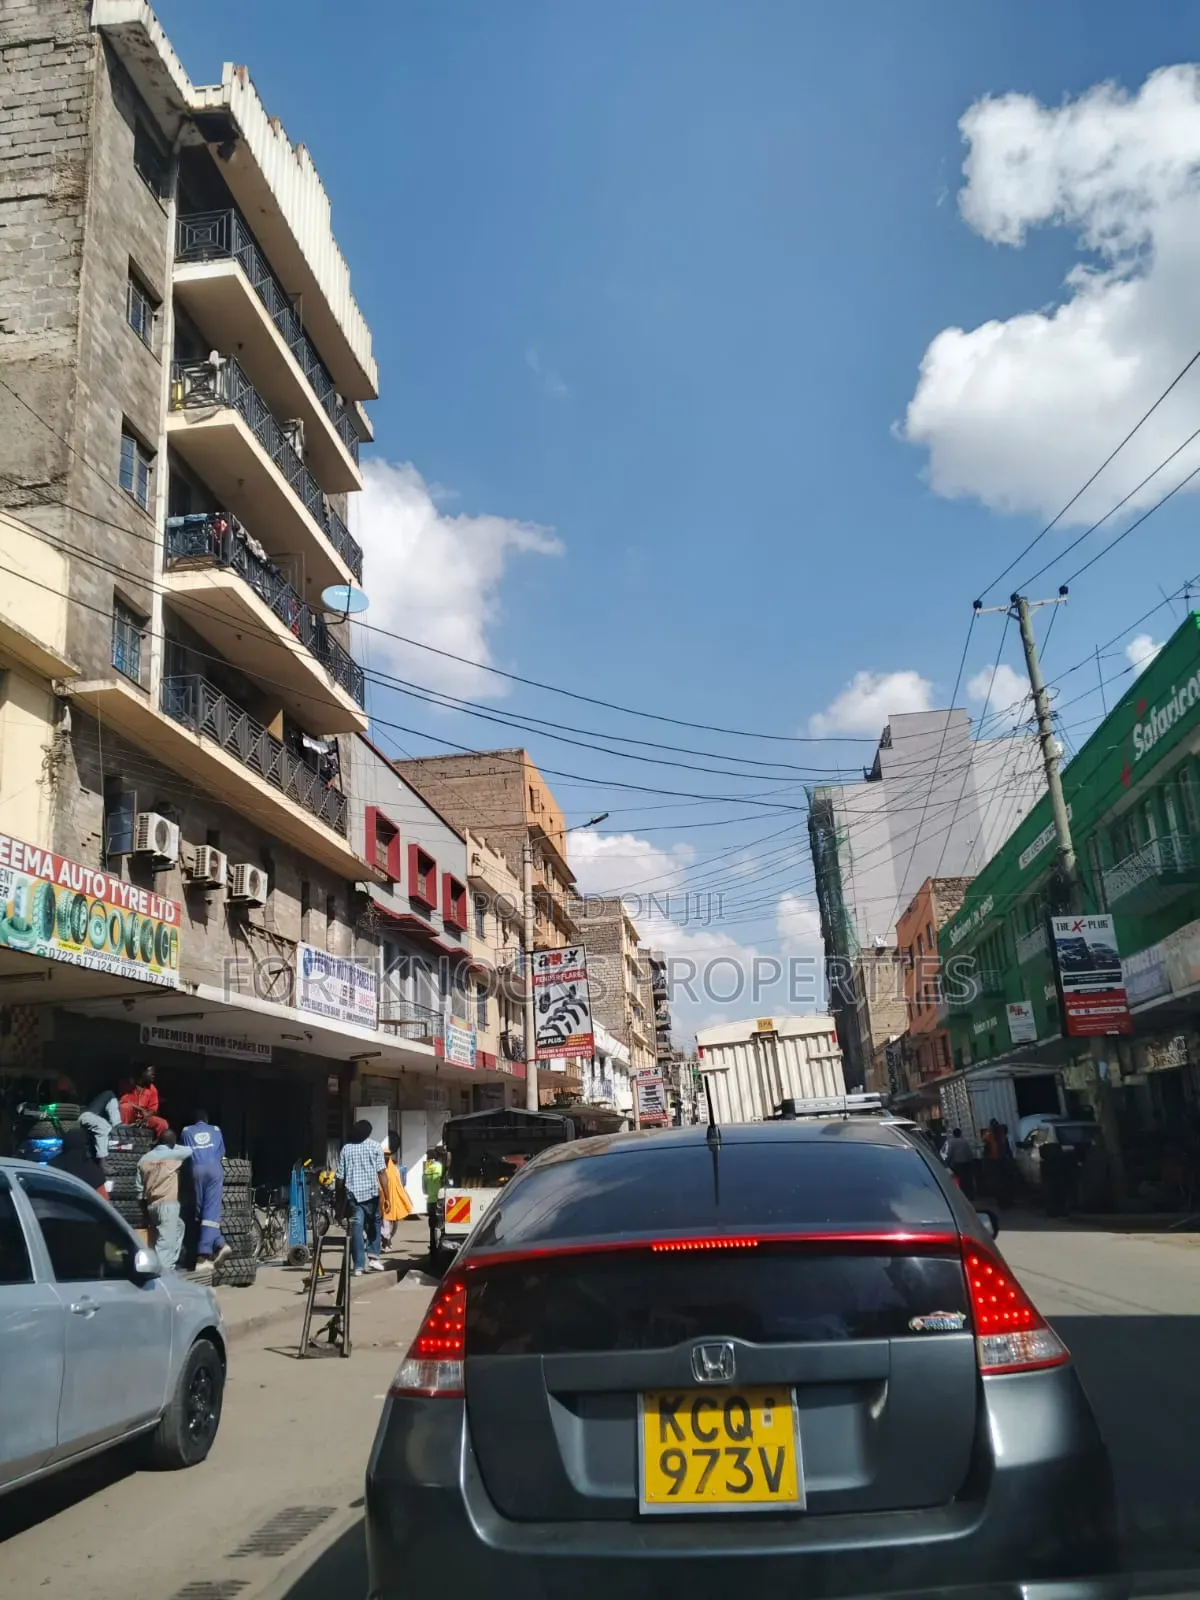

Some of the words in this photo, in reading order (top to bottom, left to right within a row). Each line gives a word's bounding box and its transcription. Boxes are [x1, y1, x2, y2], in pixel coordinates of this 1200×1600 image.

[58, 861, 105, 898] AUTO
[108, 880, 146, 914] TYRE
[150, 893, 175, 923] LTD
[48, 948, 73, 963] 0722
[75, 955, 94, 968] 517
[97, 960, 112, 971] 124
[121, 967, 141, 979] 0721
[151, 1026, 194, 1043] PREMIER
[195, 1033, 226, 1048] MOTOR
[228, 1038, 256, 1053] SPARES
[659, 1394, 753, 1443] KCQ
[659, 1446, 785, 1496] 973V
